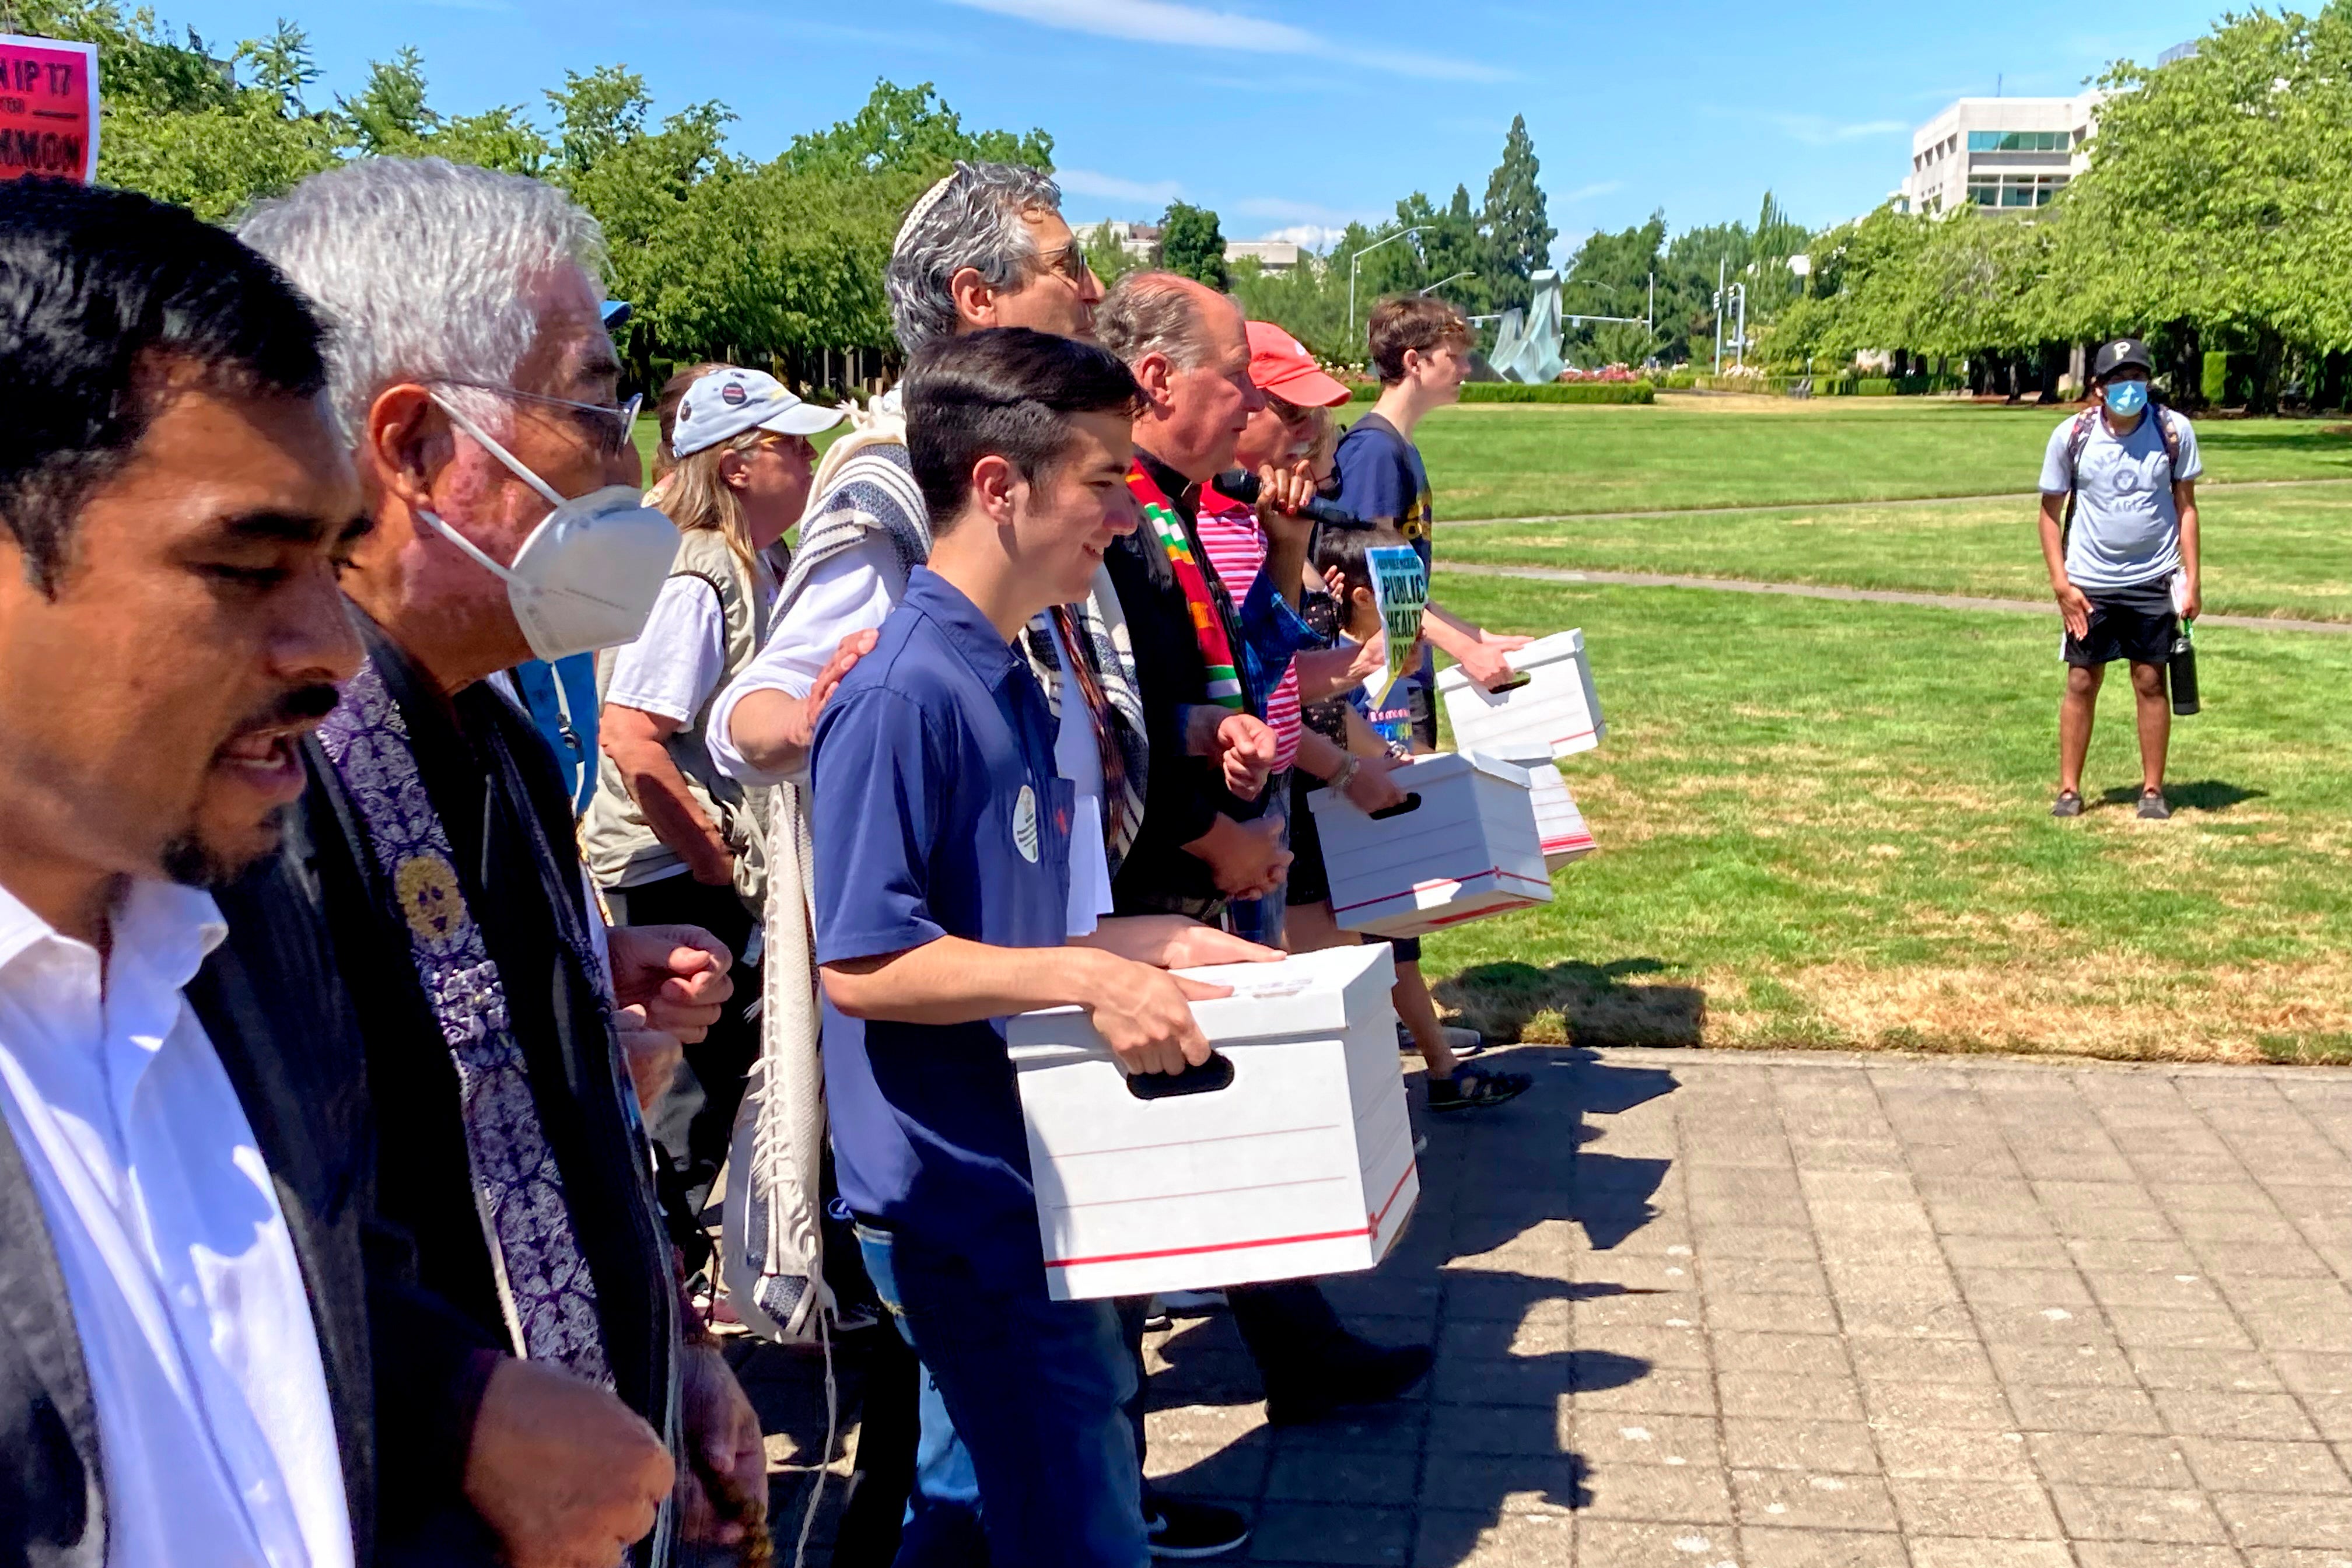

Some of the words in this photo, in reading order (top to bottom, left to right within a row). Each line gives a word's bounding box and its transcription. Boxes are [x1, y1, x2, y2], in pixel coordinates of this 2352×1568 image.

[13, 58, 40, 92] IP
[44, 62, 72, 97] 17
[2113, 341, 2131, 360] P
[1382, 573, 1425, 605] PUBLIC
